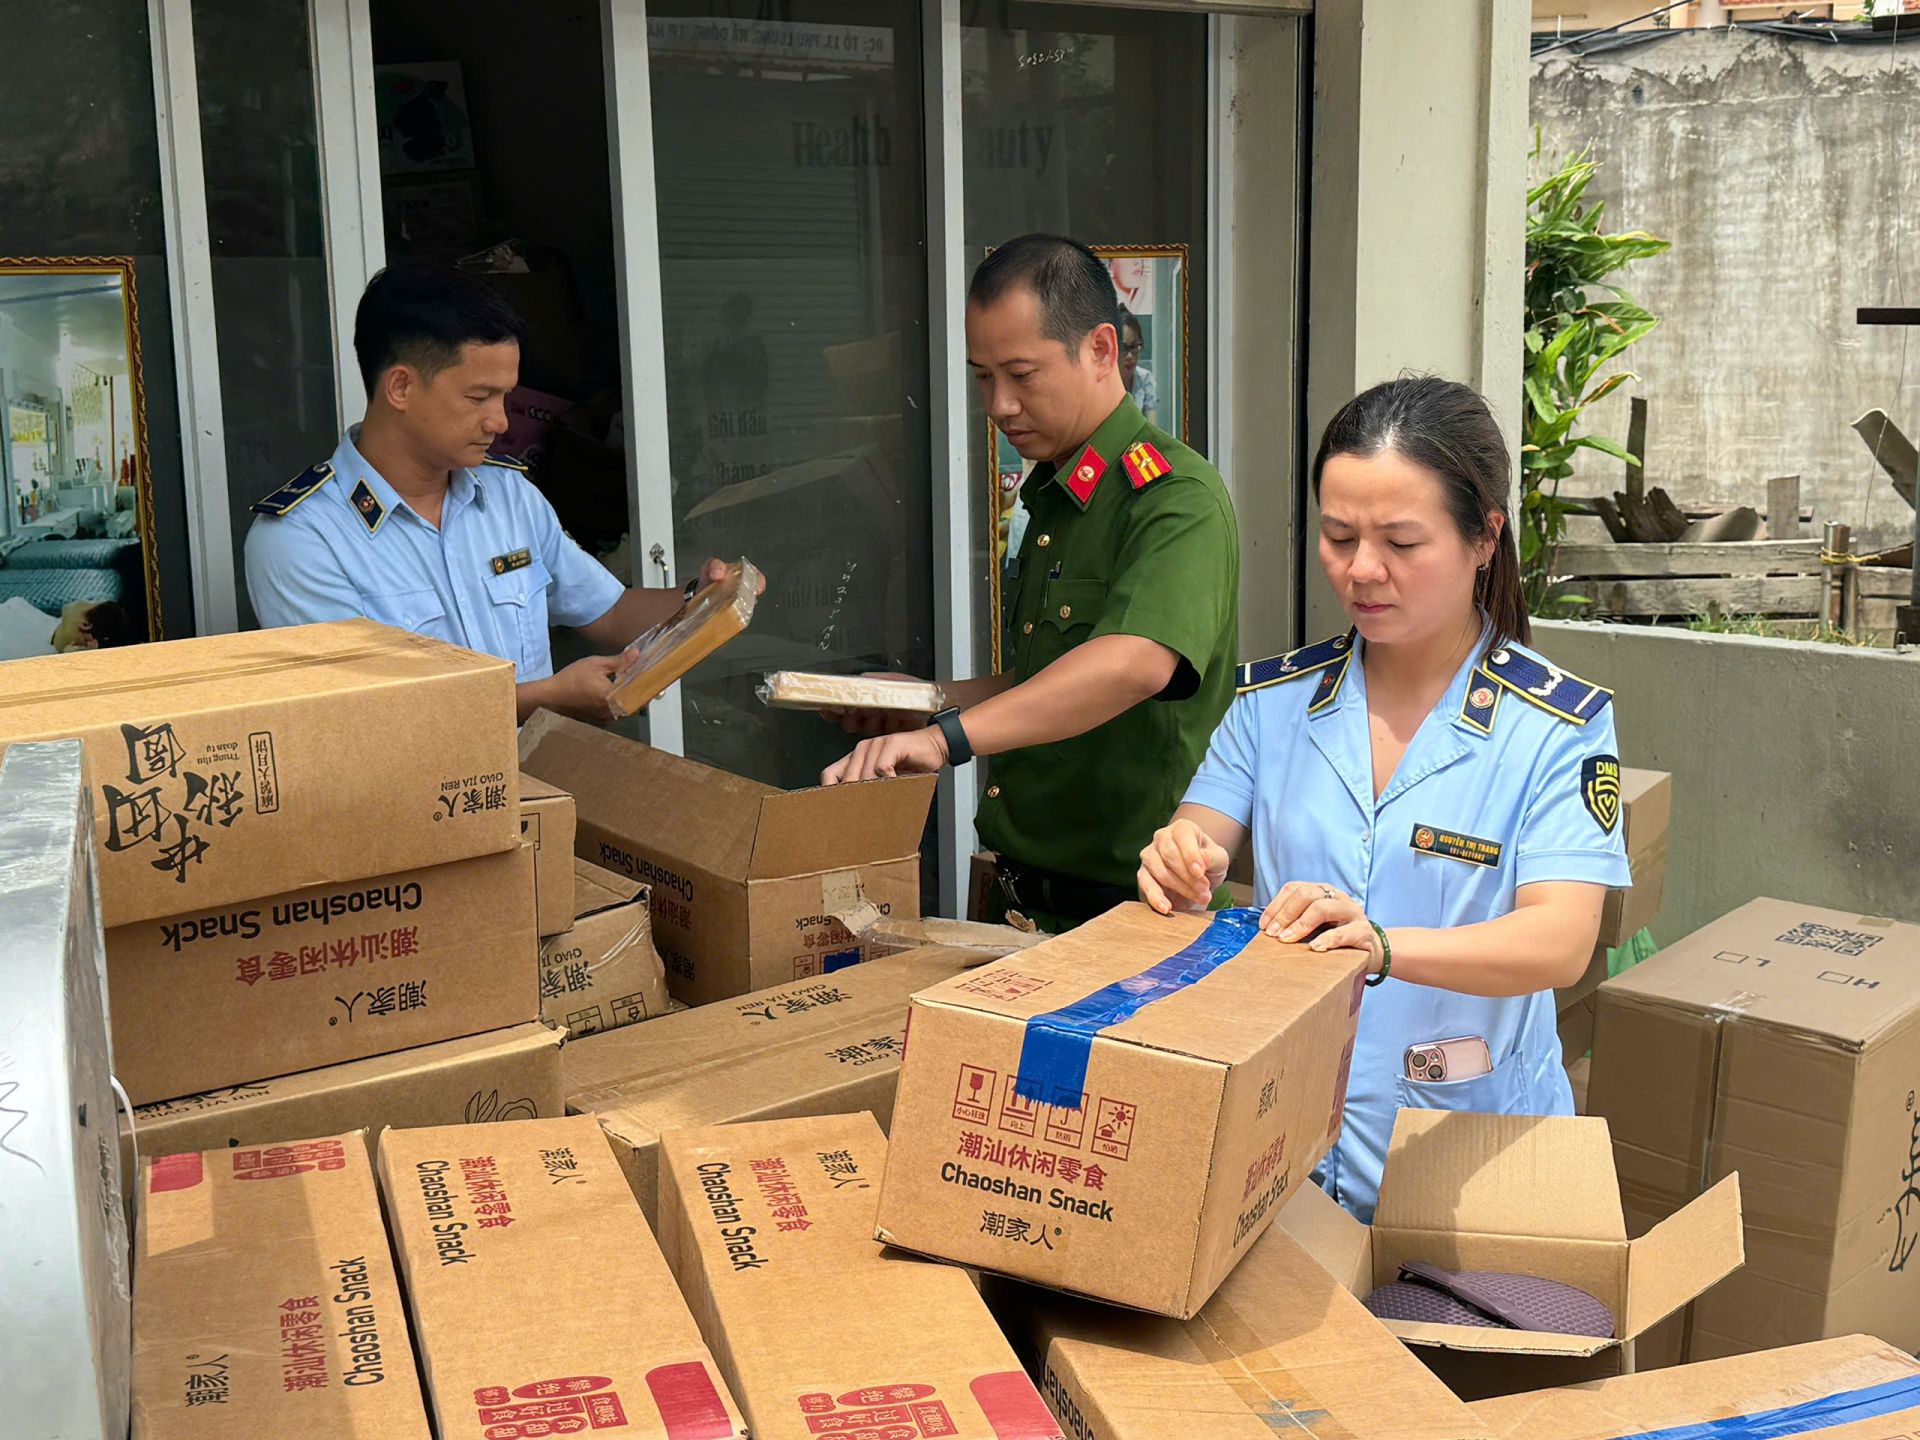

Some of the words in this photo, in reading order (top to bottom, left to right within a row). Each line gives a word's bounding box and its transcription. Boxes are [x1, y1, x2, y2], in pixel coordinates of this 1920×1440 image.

[793, 114, 891, 168] Health
[975, 118, 1055, 179] auty
[441, 780, 460, 792] REN
[463, 775, 478, 788] JIA
[479, 772, 504, 784] CHAO
[1596, 761, 1618, 778] DMS
[599, 841, 633, 874] Snack
[636, 857, 693, 902] Chaoshan
[272, 882, 422, 927] Chaoshan
[795, 914, 832, 931] Snack
[160, 910, 261, 952] Snack
[235, 926, 419, 986] 潮汕休闲零食
[554, 948, 582, 964] CHAO
[541, 961, 594, 999] 潮家
[824, 1029, 904, 1064] 潮家
[957, 1130, 1108, 1191] 潮汕休闲零食
[415, 1160, 459, 1220] Chaoshan
[458, 1155, 516, 1230] 潮汕休闲零食
[749, 1157, 814, 1233] 潮汕休闲零食
[941, 1161, 1042, 1204] Chaoshan
[1048, 1187, 1114, 1223] Snack
[697, 1162, 744, 1224] Chaoshan
[721, 1226, 769, 1272] Snack
[432, 1222, 477, 1267] Snack
[330, 1256, 372, 1303] Snack
[278, 1296, 328, 1392] 潮汕休闲零食
[339, 1305, 385, 1386] Chaoshan
